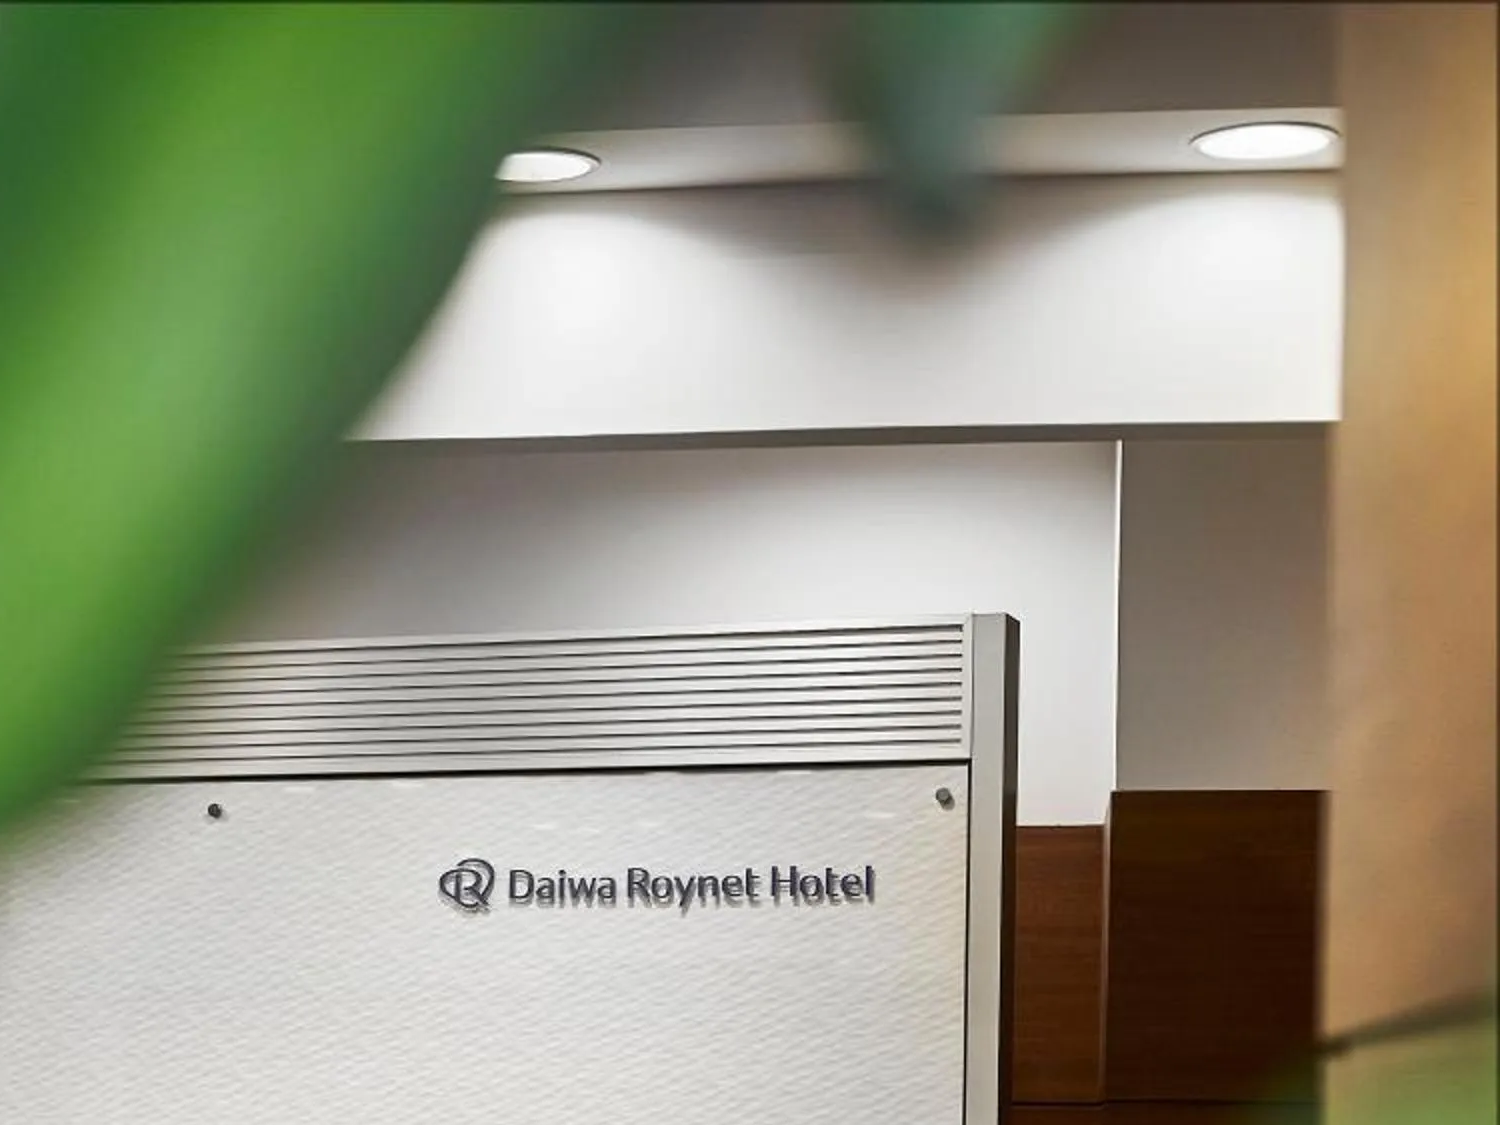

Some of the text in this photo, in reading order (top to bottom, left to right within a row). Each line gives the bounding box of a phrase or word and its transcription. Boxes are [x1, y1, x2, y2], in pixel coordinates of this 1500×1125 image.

[508, 868, 617, 901] Daiwa
[626, 866, 759, 913] Roynet
[770, 864, 875, 899] Hotel
